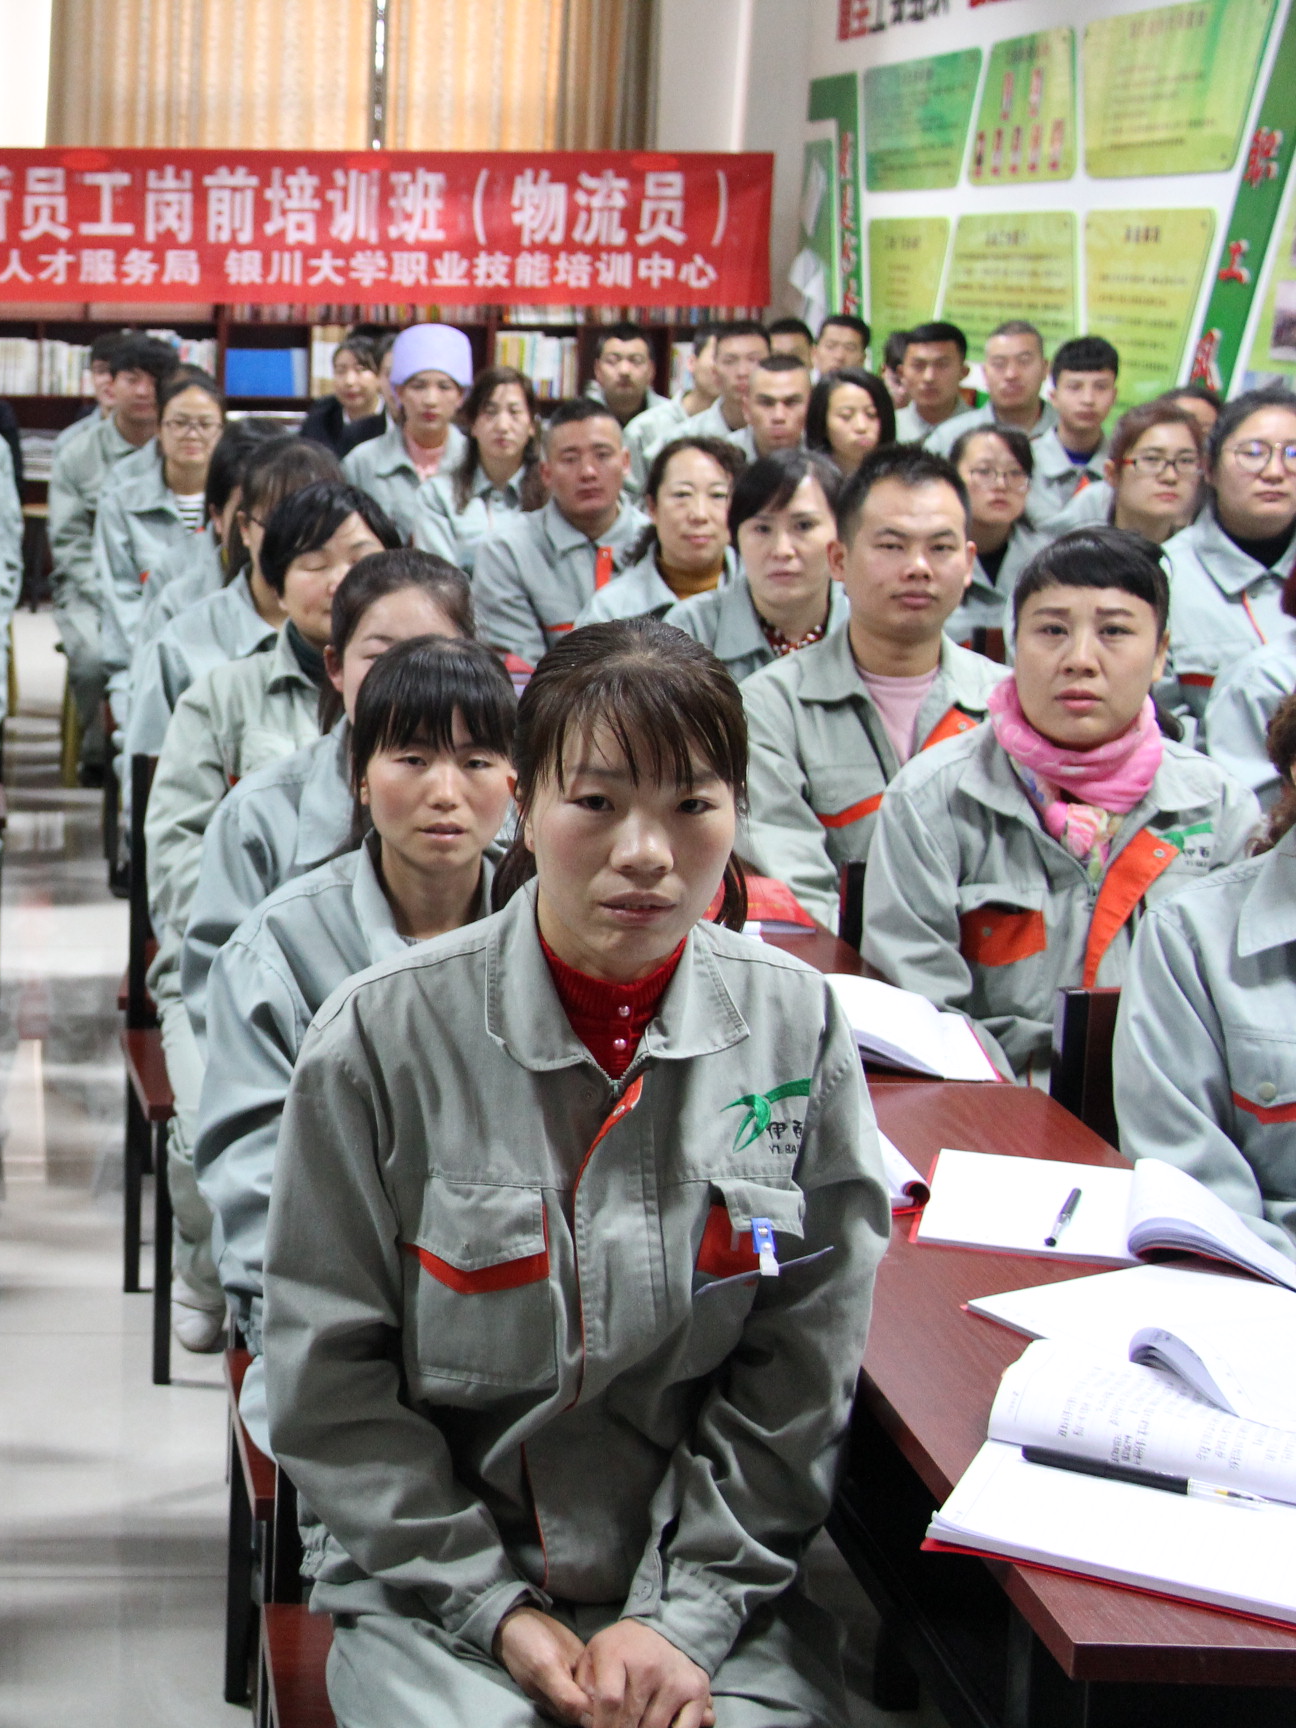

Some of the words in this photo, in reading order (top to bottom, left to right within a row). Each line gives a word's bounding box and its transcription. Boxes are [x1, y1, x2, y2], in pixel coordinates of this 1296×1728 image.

[223, 249, 719, 289] 银川大学职业技能培训中心
